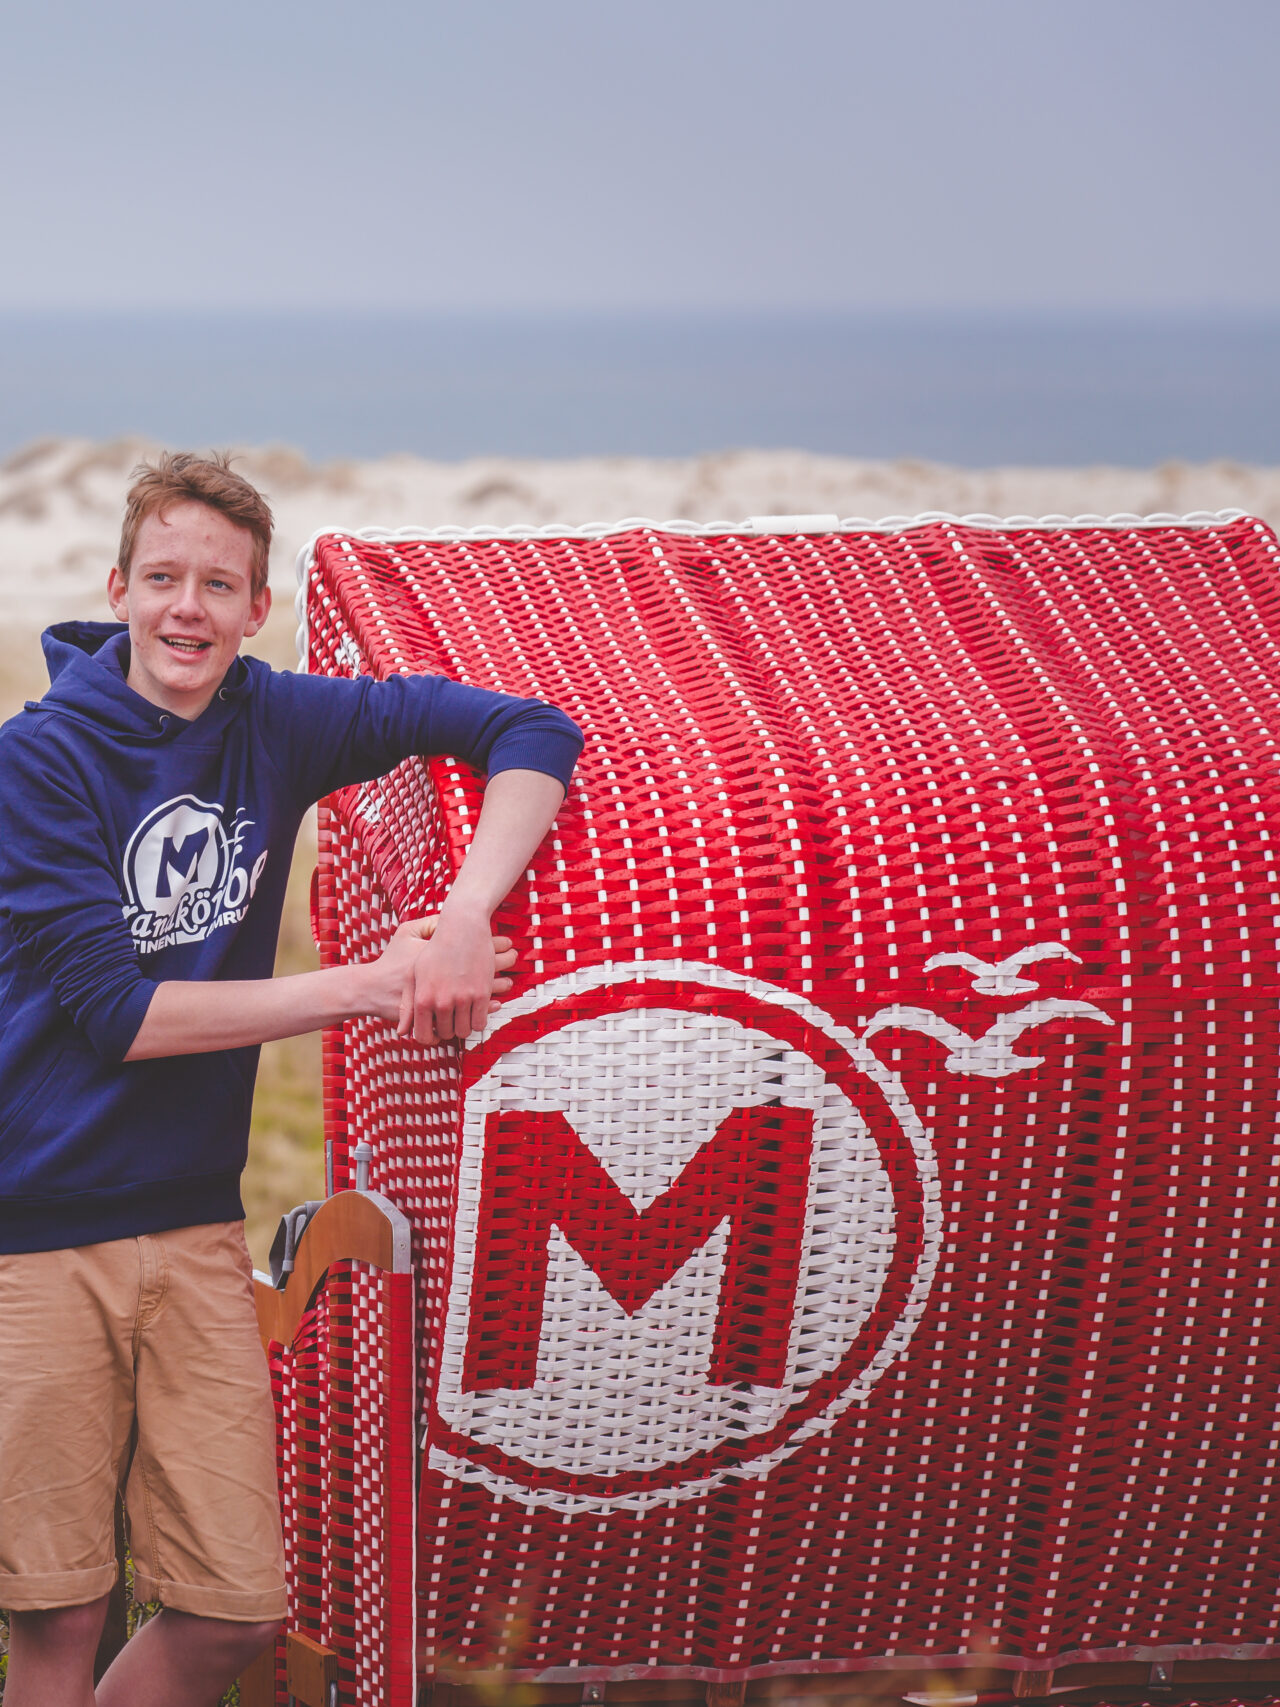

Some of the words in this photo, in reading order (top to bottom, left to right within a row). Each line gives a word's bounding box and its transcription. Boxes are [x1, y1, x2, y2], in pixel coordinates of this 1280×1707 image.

[156, 827, 209, 898] M
[206, 904, 249, 937] AMRU
[461, 1106, 815, 1390] M
